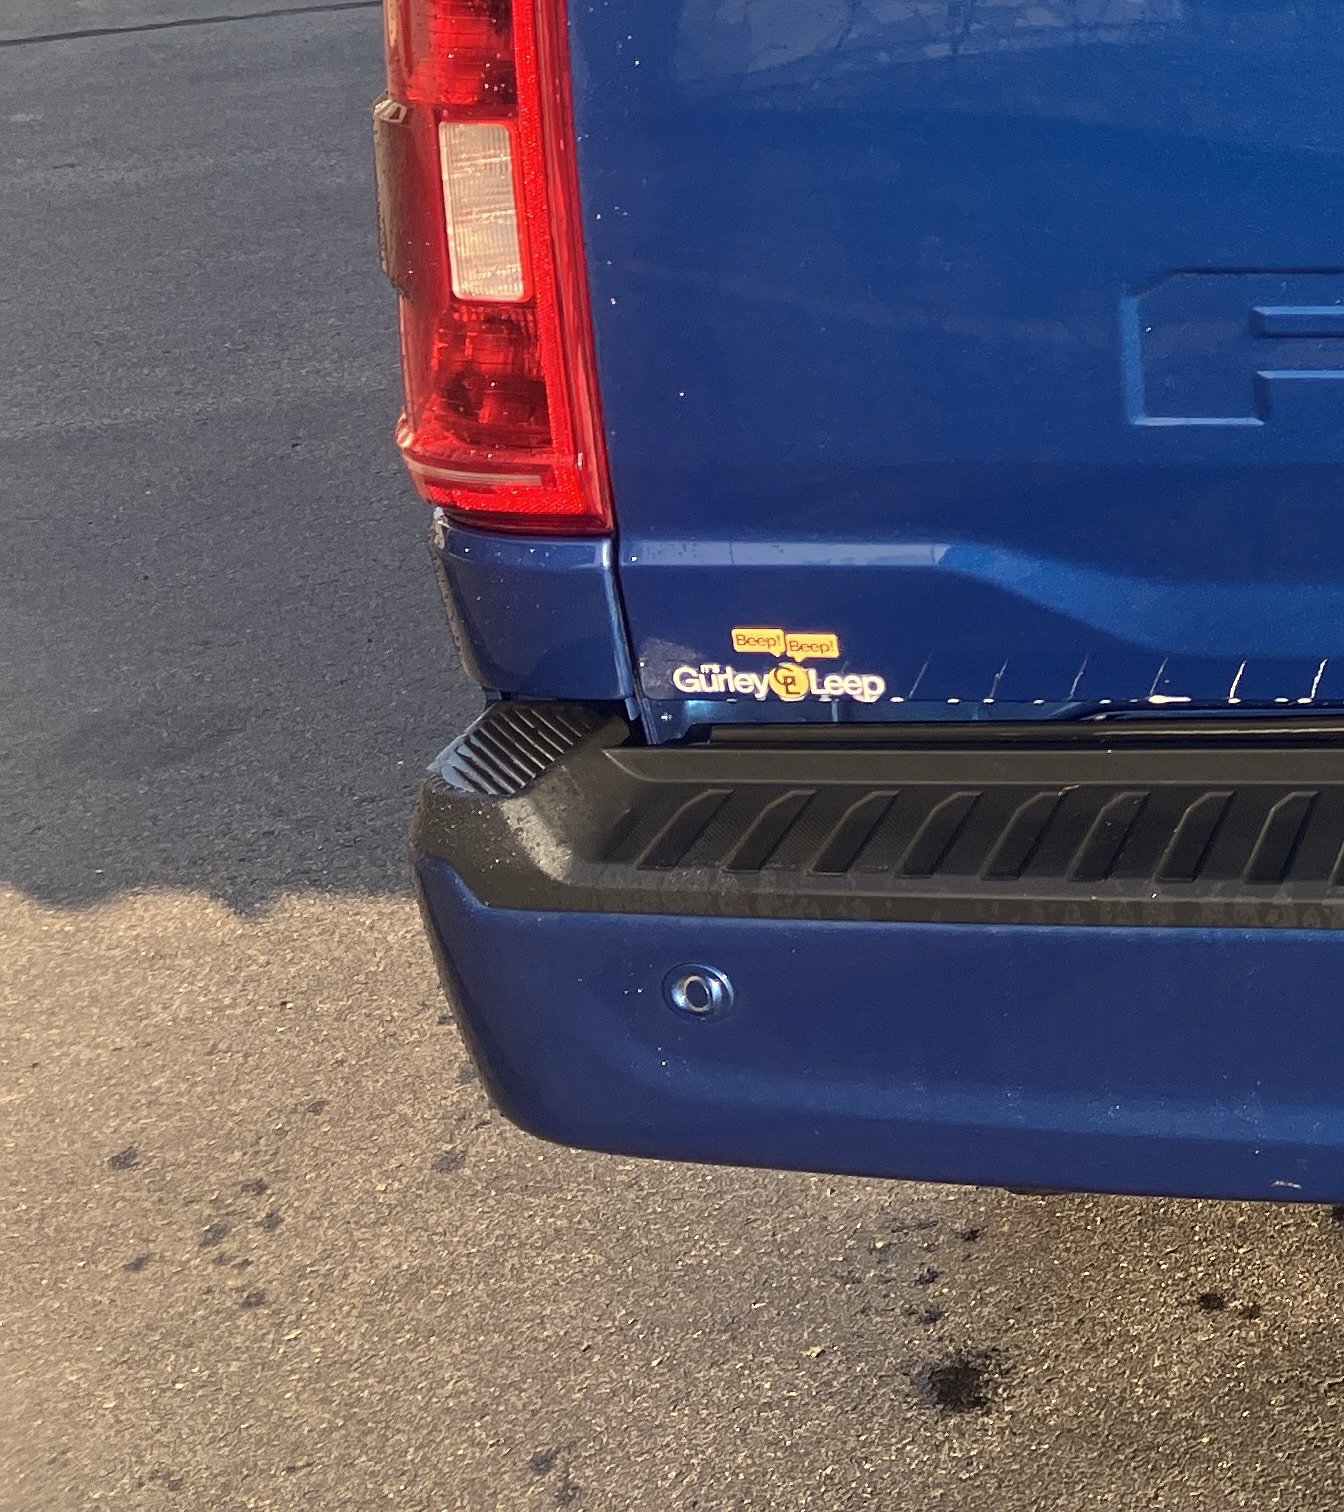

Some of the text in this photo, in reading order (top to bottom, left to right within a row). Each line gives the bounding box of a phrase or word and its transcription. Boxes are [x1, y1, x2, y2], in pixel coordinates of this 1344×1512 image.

[735, 634, 782, 649] Beep!
[789, 640, 834, 654] Beep!
[808, 668, 885, 702] Leep
